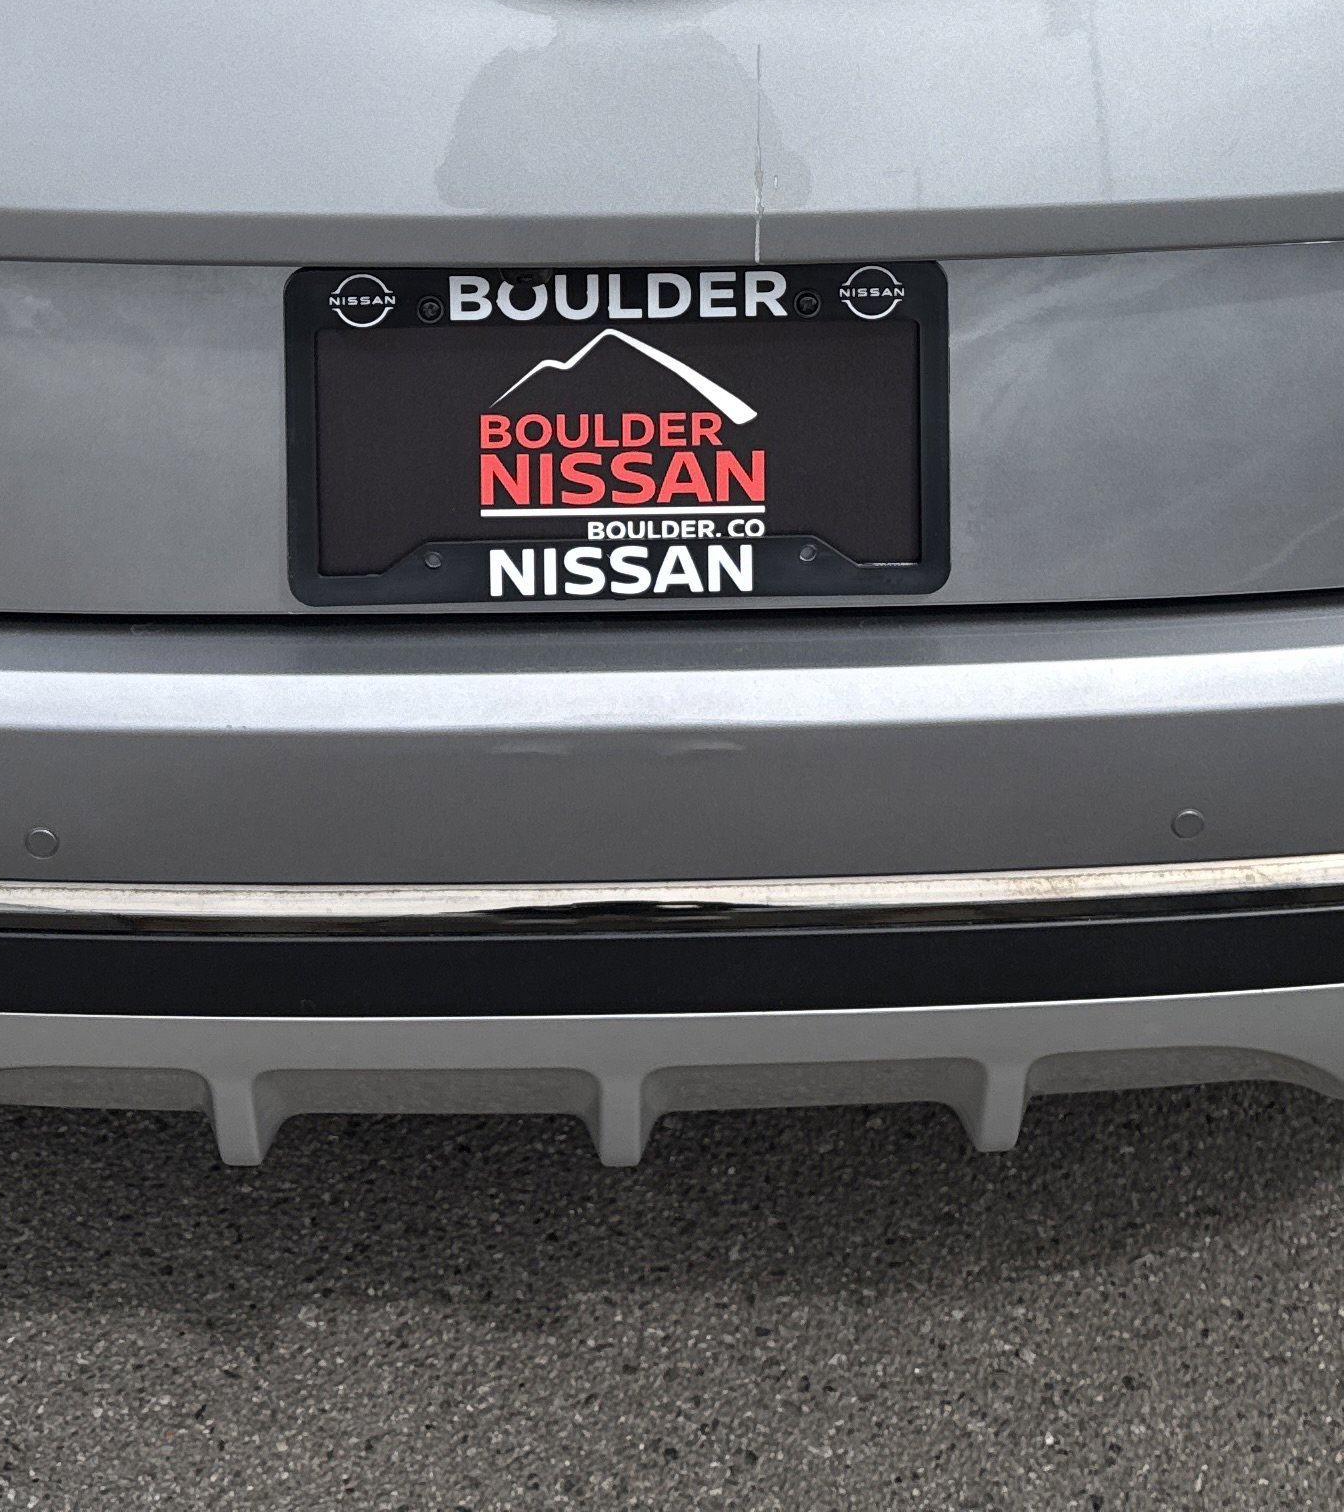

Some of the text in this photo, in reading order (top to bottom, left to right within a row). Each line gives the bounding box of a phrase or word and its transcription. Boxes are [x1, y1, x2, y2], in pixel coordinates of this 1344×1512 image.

[329, 296, 396, 306] NISSAN
[448, 271, 788, 322] BOULDER
[839, 287, 905, 297] NISSAN
[480, 412, 723, 449] BOULDER
[480, 450, 765, 505] NISSAN
[727, 518, 765, 537] CO
[489, 545, 753, 597] NISSAN
